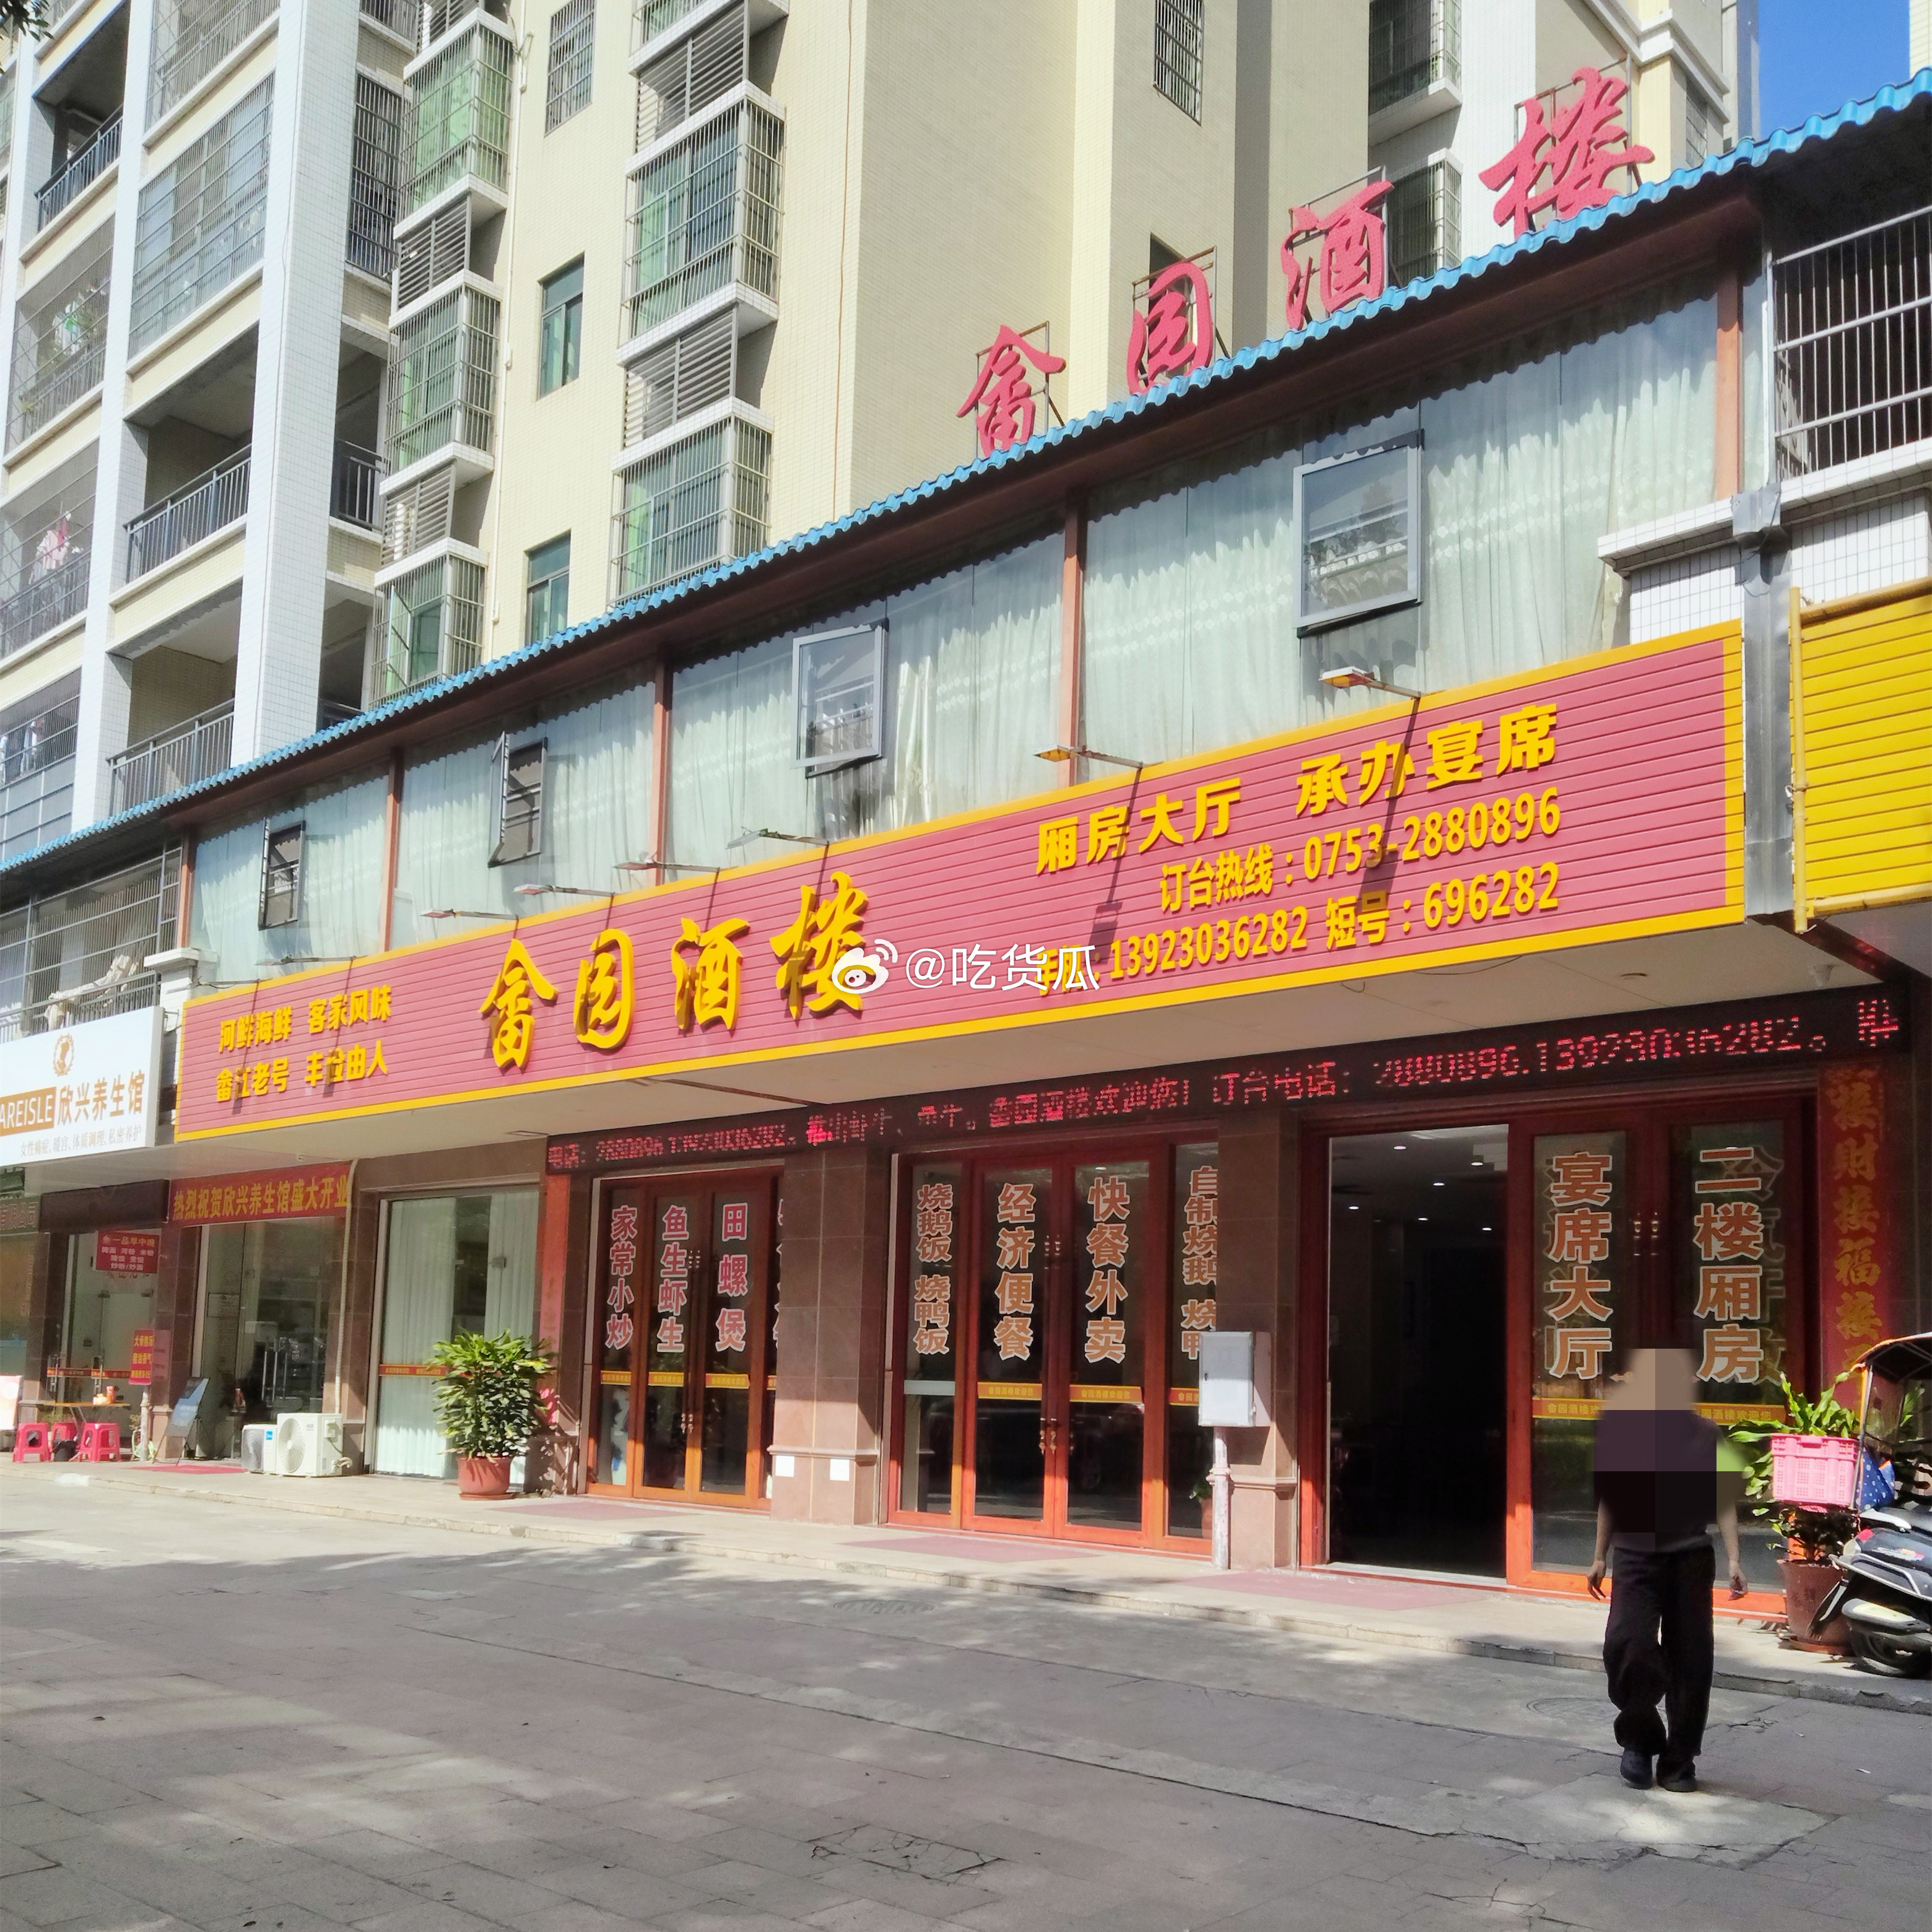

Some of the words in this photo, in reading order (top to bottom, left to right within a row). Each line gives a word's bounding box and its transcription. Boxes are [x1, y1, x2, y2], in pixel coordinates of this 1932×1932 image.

[1036, 778, 1241, 875] 厢房大厅
[1295, 703, 1556, 818] 承办宴席
[1325, 861, 1559, 949] 短号：696282
[218, 1006, 292, 1053] 河鲜海鲜
[308, 984, 391, 1035] 客家风味
[305, 1039, 388, 1087] 丰俭由人
[57, 1069, 145, 1126] 欣兴养生馆
[173, 1175, 347, 1221] 热烈祝贺欣兴养生馆盛大开业
[916, 1183, 953, 1262] 烧鹅饭
[605, 1205, 638, 1350] 家常小炒
[656, 1205, 689, 1352] 鱼生虾生
[715, 1202, 749, 1352] 田螺煲
[913, 1274, 951, 1354] 烧鸭饭
[994, 1183, 1036, 1360] 经济便餐
[1085, 1177, 1130, 1363] 快餐外卖
[1548, 1151, 1613, 1380] 宴席大厅
[1693, 1147, 1764, 1383] 二楼厢房
[1695, 1406, 1772, 1421] 园酒楼欢迎您
